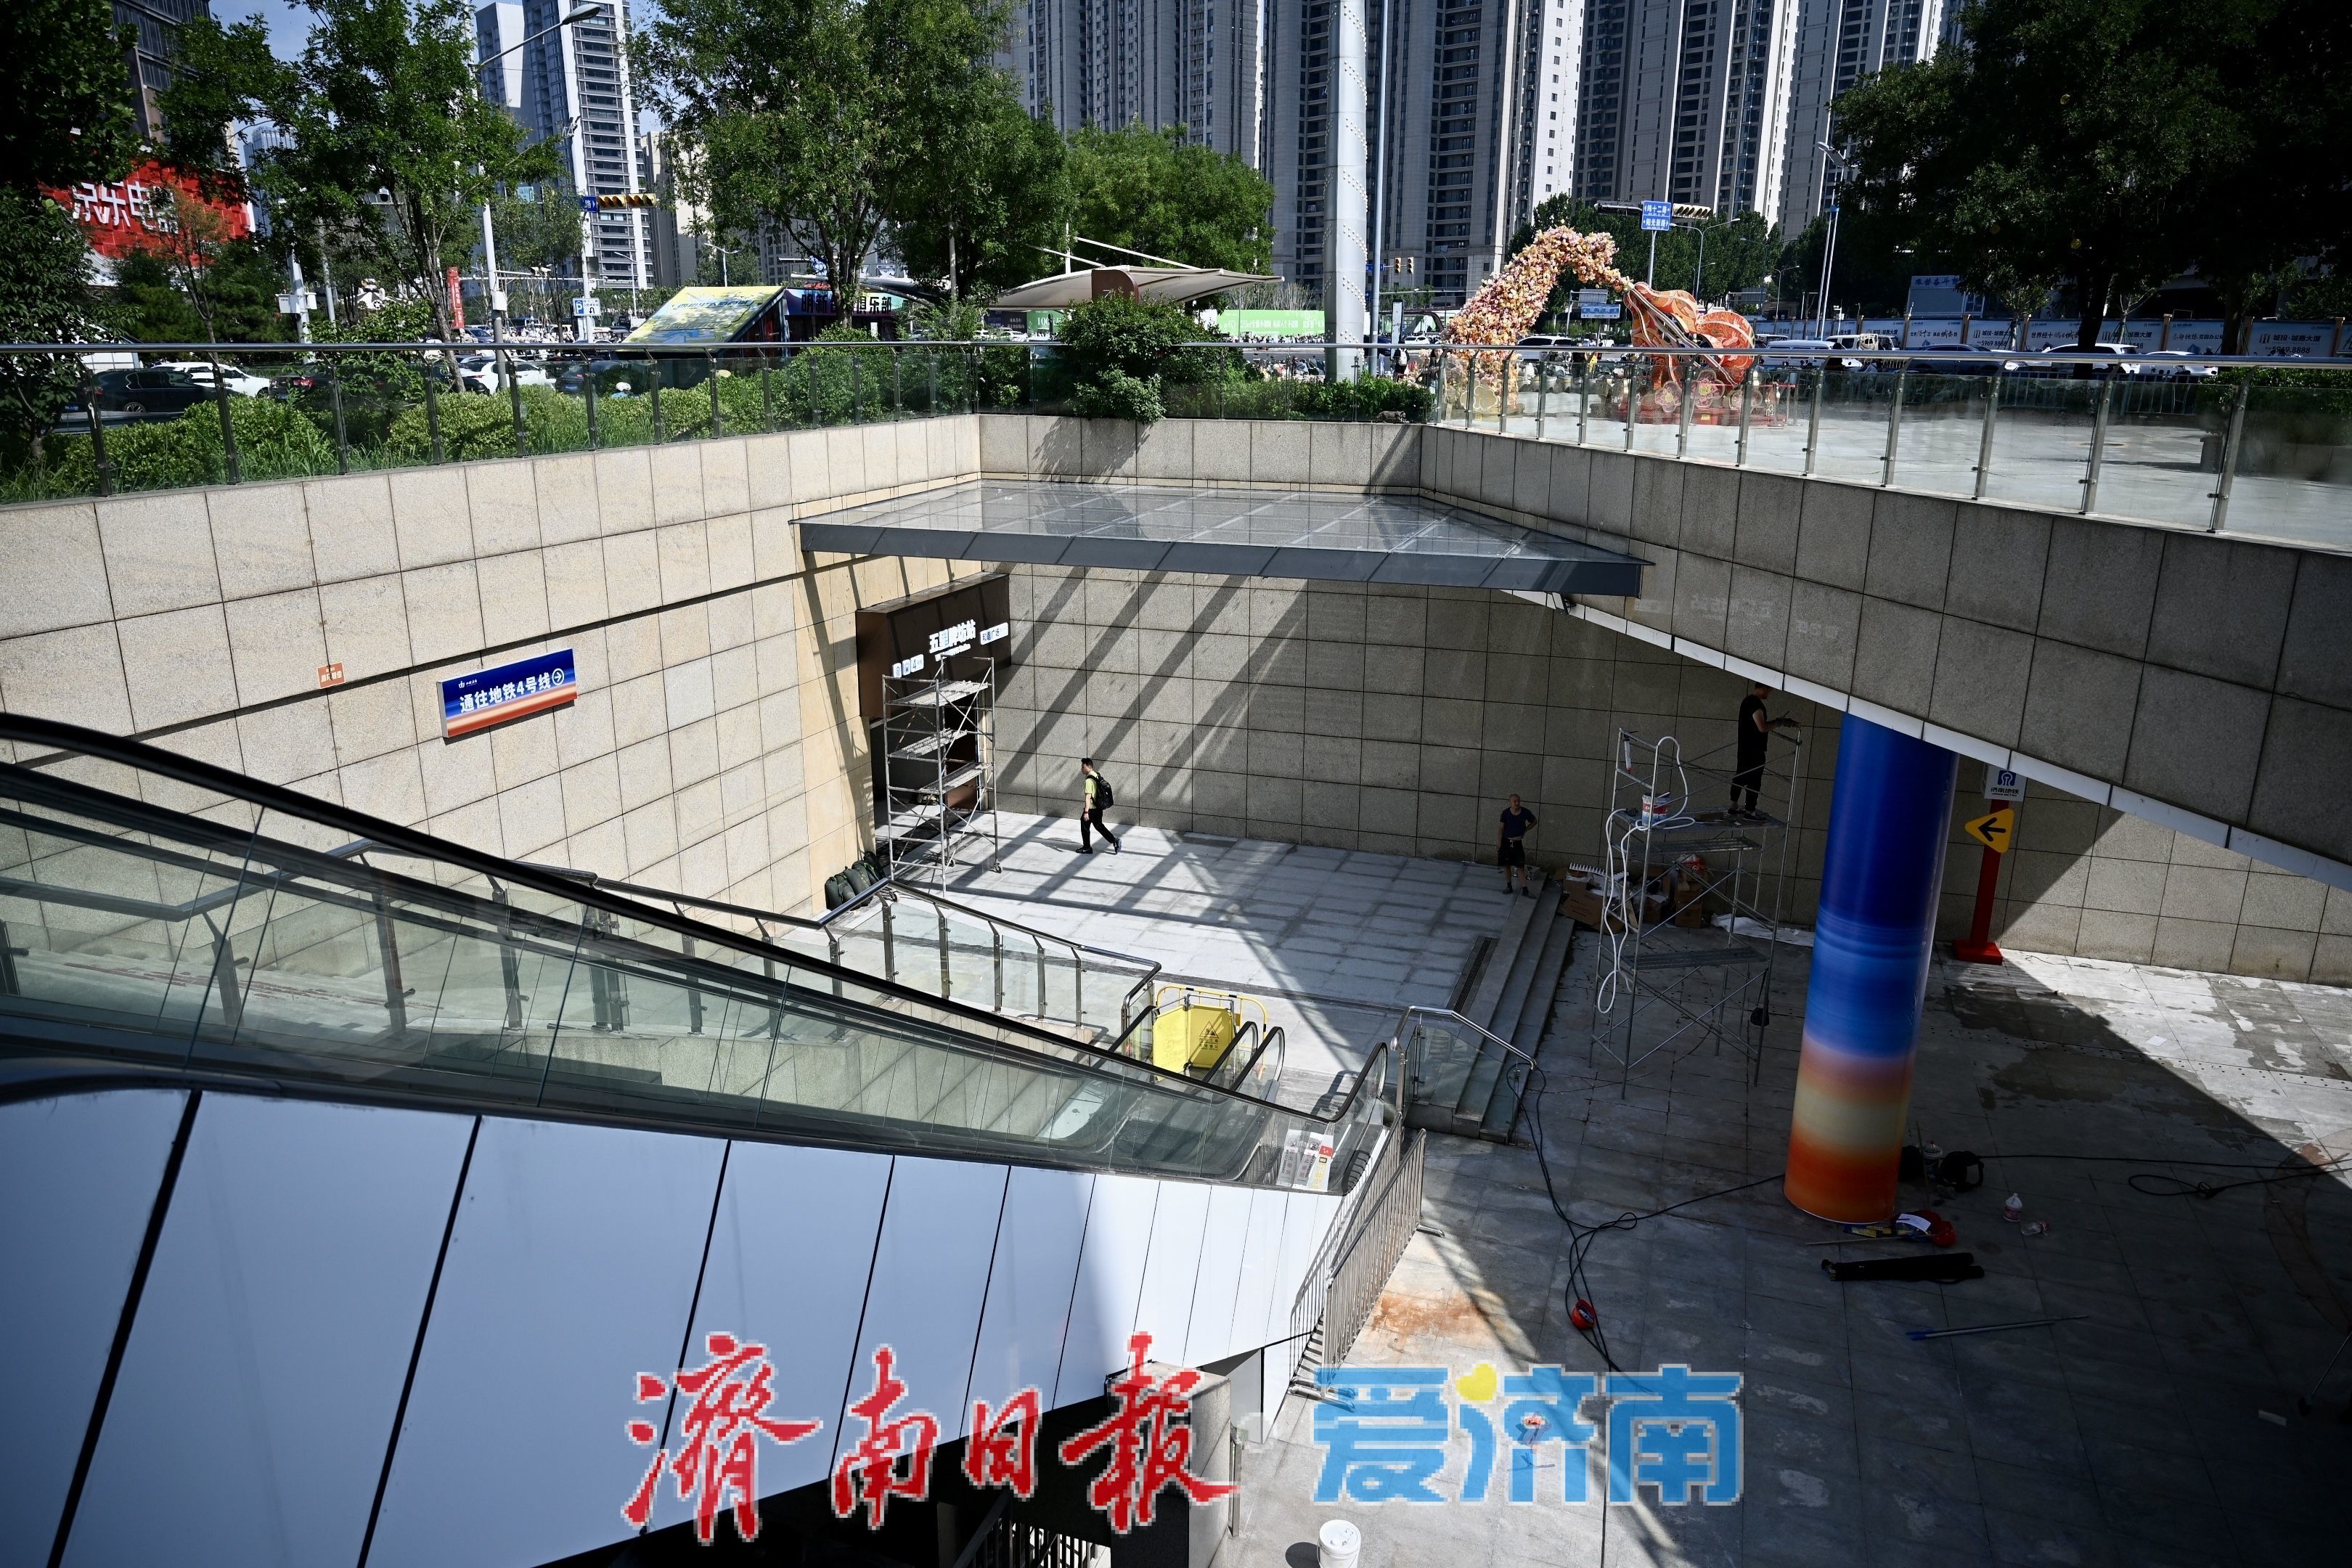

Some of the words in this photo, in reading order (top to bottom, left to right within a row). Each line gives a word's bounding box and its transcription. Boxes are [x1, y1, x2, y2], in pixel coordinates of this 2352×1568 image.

[460, 672, 552, 713] 通往地铁4号线
